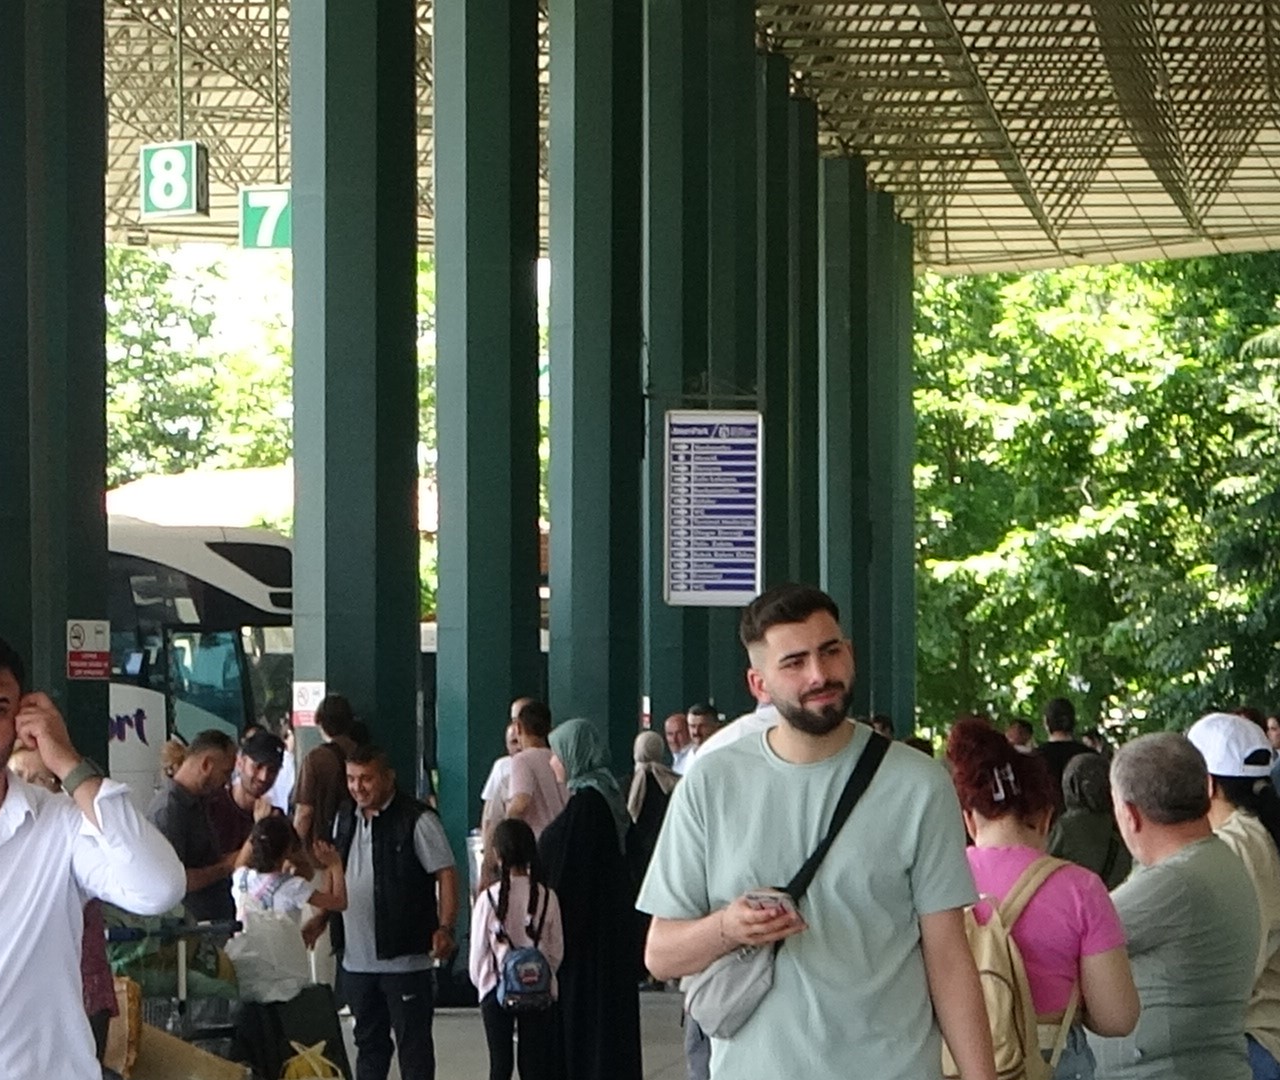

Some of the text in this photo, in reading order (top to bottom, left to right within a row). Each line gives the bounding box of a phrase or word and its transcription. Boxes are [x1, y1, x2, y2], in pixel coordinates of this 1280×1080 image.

[149, 149, 188, 209] 8
[248, 191, 288, 246] 7
[108, 708, 149, 747] ort
